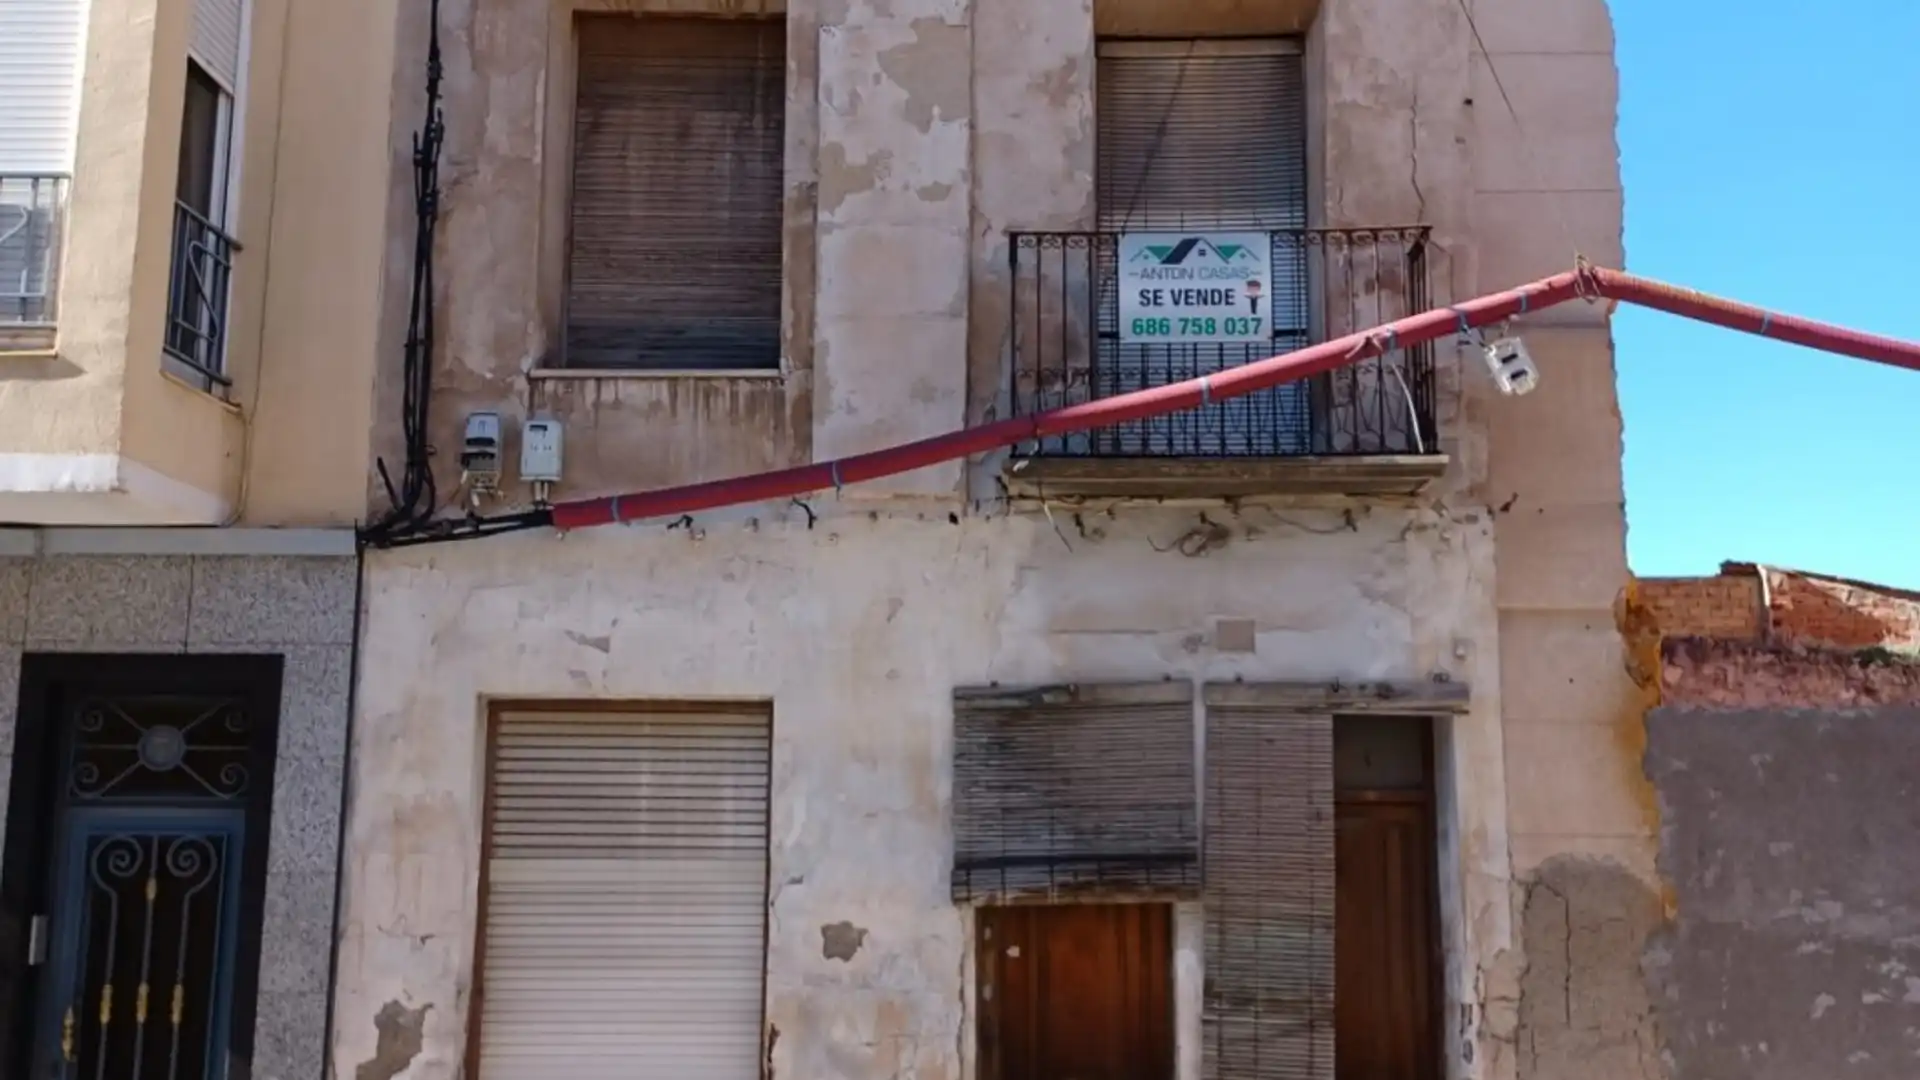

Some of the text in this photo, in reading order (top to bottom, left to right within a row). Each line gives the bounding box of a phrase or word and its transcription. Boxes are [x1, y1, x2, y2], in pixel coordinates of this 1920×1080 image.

[1140, 267, 1250, 280] ANTON CASAS
[1138, 288, 1236, 306] SE VENDE
[1132, 317, 1263, 336] 686 758 037
